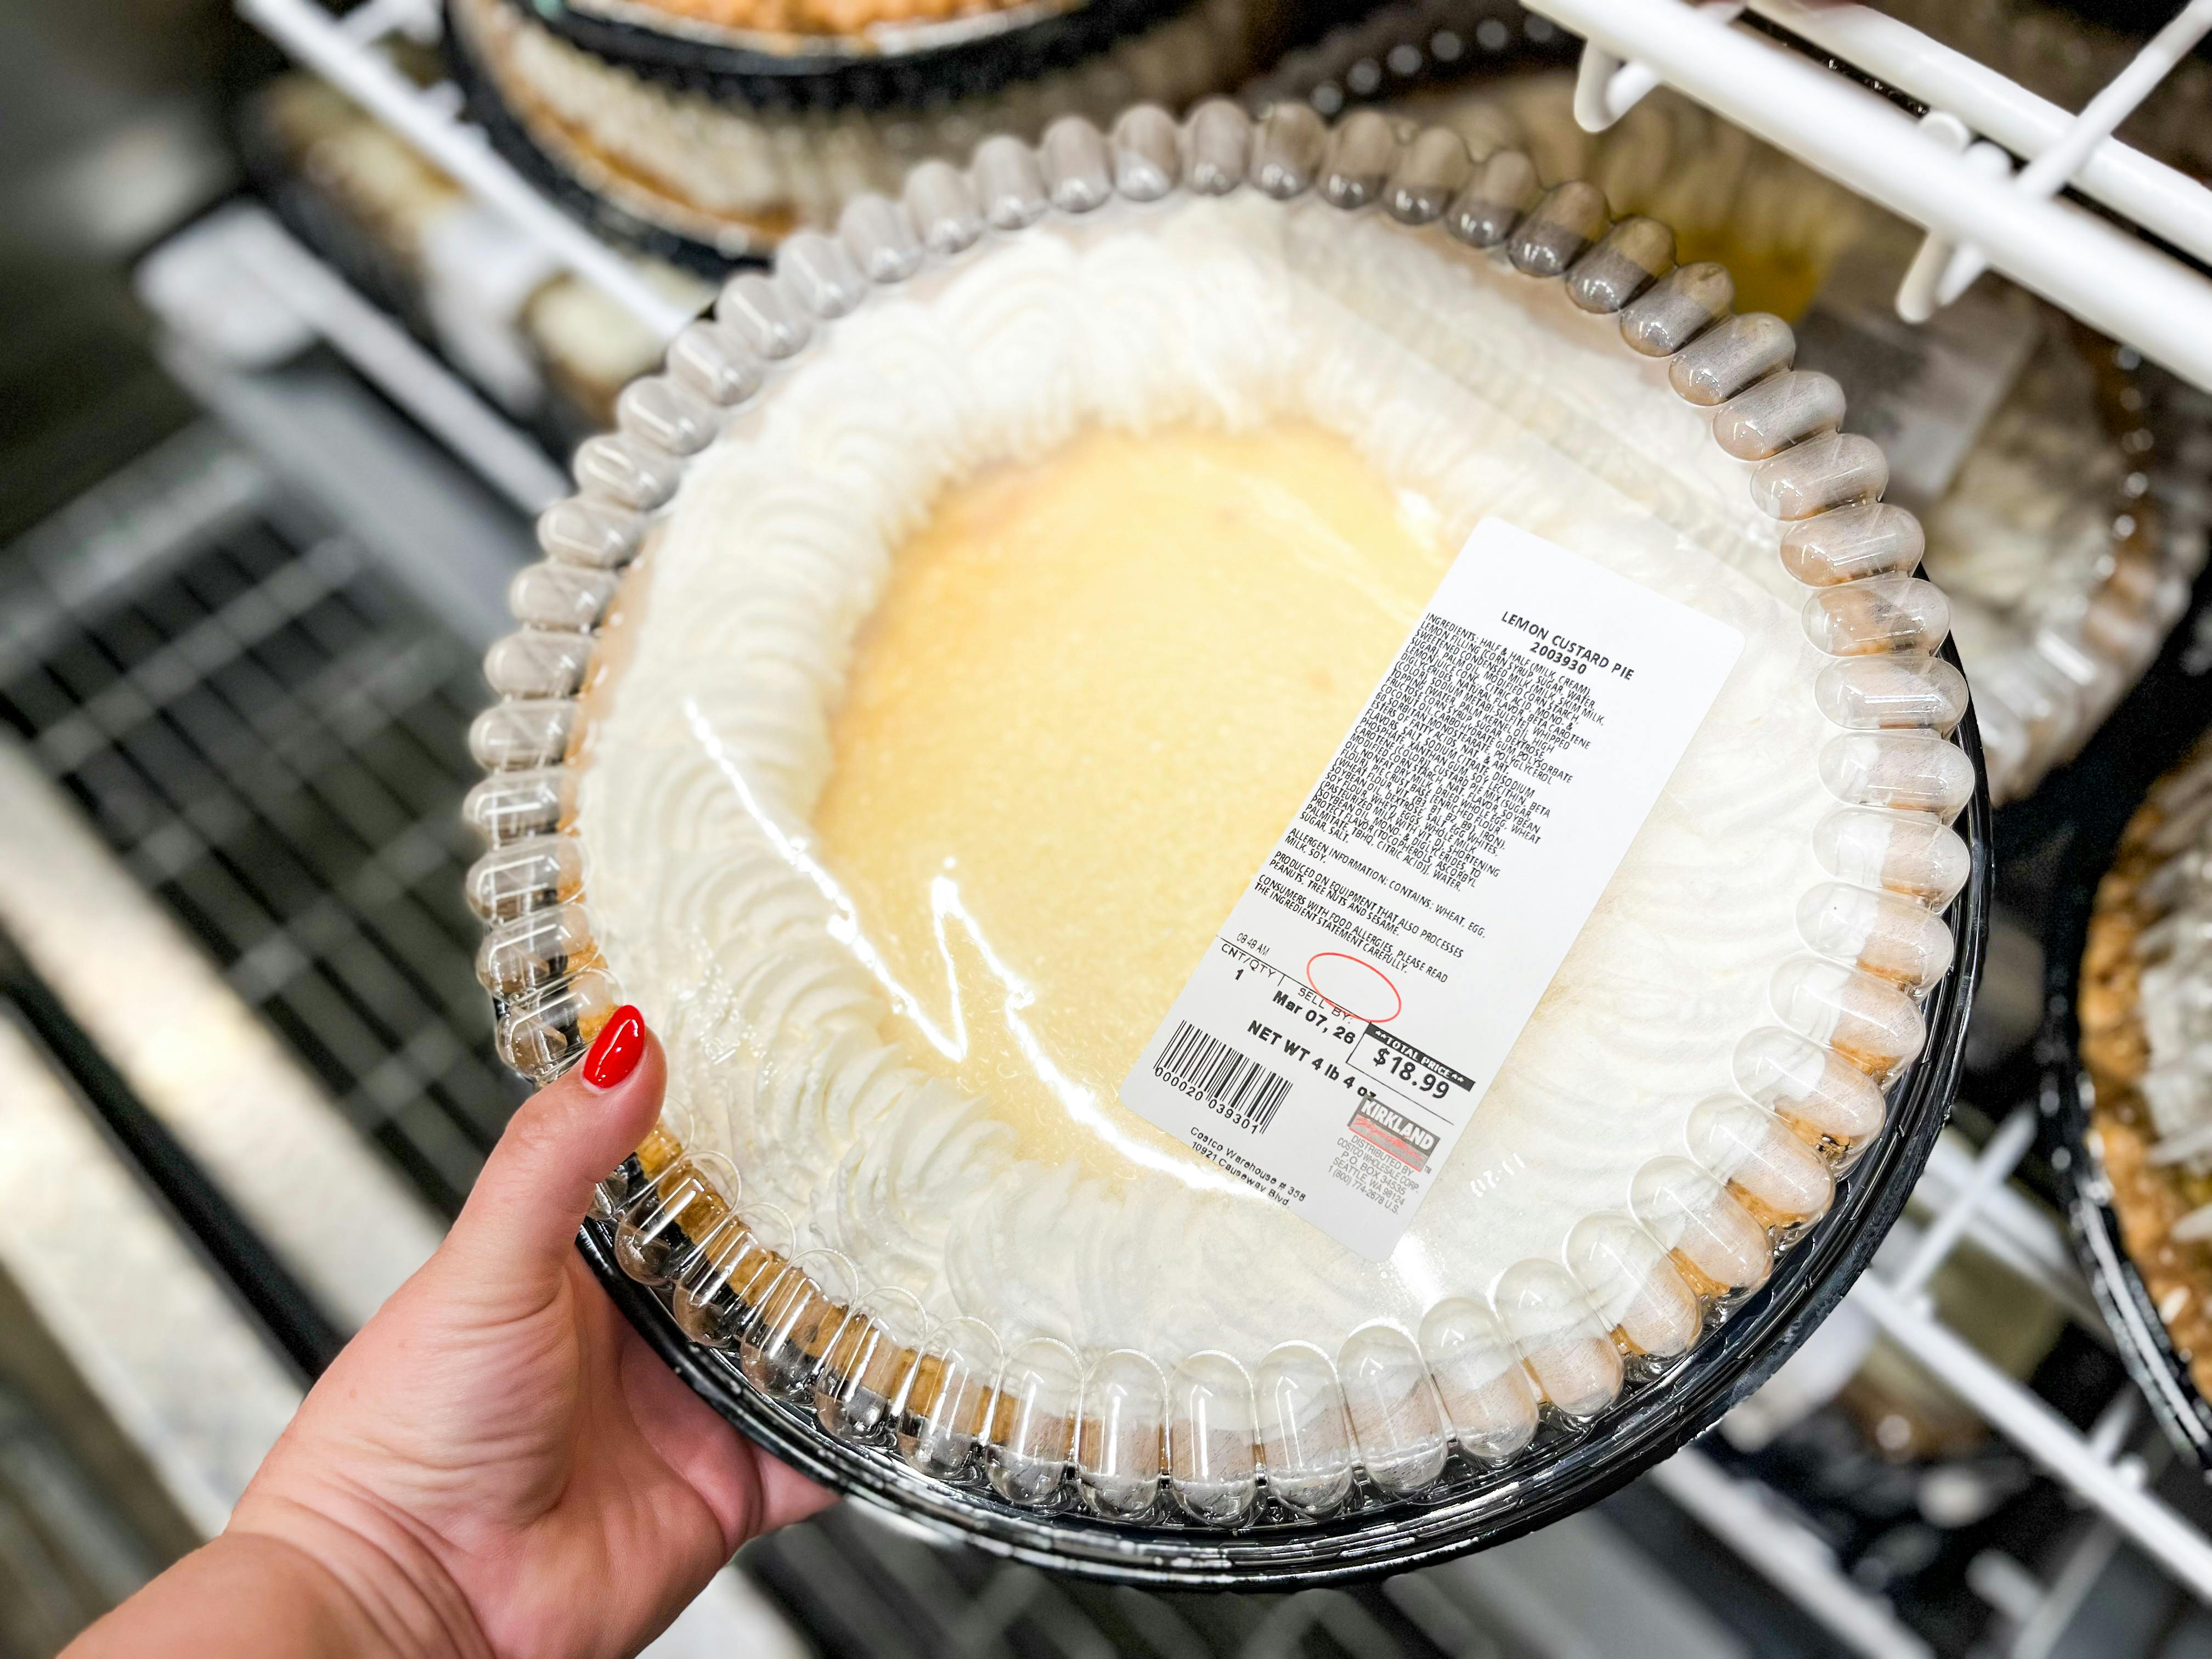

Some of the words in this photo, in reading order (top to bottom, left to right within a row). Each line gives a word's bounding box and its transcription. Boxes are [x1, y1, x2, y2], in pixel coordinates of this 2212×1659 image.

[1420, 620, 1451, 640] LEMON
[1449, 634, 1481, 654] FILLING
[1425, 612, 1479, 643] INGREDIENTS:
[1479, 637, 1502, 652] HALF
[1508, 651, 1531, 667] HALF
[1501, 611, 1549, 640] LEMON
[1551, 635, 1609, 668] CUSTARD
[1611, 662, 1635, 681] PIE
[1530, 641, 1587, 675] 2003930
[1380, 684, 1420, 707] COCONUT
[1385, 675, 1424, 699] FRUCTOSE
[1423, 692, 1447, 711] CORN
[1405, 645, 1436, 664] LEMON
[1433, 658, 1457, 674] JUICE
[1485, 682, 1511, 701] CITRIC
[1534, 707, 1564, 725] MONO-
[1415, 628, 1460, 655] SWEETENED
[1460, 650, 1508, 678] CONDENSED
[1508, 673, 1531, 689] MILK
[1558, 697, 1582, 713] SKIM
[1442, 652, 1466, 668] PALM
[1483, 671, 1523, 696] MODIFIED
[1523, 691, 1548, 708] CORN
[1370, 699, 1397, 718] ESTERS
[1409, 718, 1435, 735] FATTY
[1460, 744, 1480, 760] NAT.
[1491, 760, 1509, 775] ART.
[1391, 667, 1426, 690] TOPPING
[1458, 701, 1483, 719] PALM
[1482, 713, 1513, 734] KERNEL
[1531, 737, 1555, 754] HIGH
[1430, 676, 1464, 698] SODIUM
[1532, 726, 1570, 750] WHIPPED
[1455, 678, 1492, 702] NATURAL
[1527, 713, 1548, 730] BETA
[1548, 724, 1591, 749] CAROTENE
[1334, 757, 1367, 777] (WHEAT
[1395, 786, 1409, 800] VIT.
[1350, 732, 1389, 757] MODIFIED
[1389, 752, 1413, 770] CORN
[1446, 781, 1465, 797] NAT.
[1500, 809, 1541, 834] SOYBEAN
[1355, 725, 1395, 750] CAROTENE
[1433, 764, 1469, 787] CUSTARD
[1469, 782, 1483, 794] PIE
[1482, 789, 1502, 804] MIX
[1407, 741, 1448, 766] XANTHAN
[1470, 772, 1489, 786] SOY
[1528, 802, 1550, 818] BETA
[1423, 737, 1458, 760] SODIUM
[1492, 771, 1535, 799] DISODIUM
[1493, 750, 1553, 785] POLYGLYCEROL
[1320, 780, 1373, 811] (PASTEURIZED
[1373, 806, 1396, 822] MILK
[1395, 817, 1418, 834] WITH
[1418, 829, 1432, 843] VIT.
[1447, 844, 1500, 877] SHORTENING
[1325, 772, 1343, 785] SOY
[1424, 822, 1454, 843] WHOLE
[1453, 838, 1477, 854] MILK
[1330, 763, 1368, 788] SOYBEAN
[1449, 824, 1466, 838] EGG
[1370, 764, 1385, 776] PIE
[1385, 771, 1410, 788] CRUST
[1409, 783, 1431, 799] BASE
[1474, 816, 1500, 836] FLOUR
[1373, 816, 1402, 836] MONO-
[1393, 765, 1412, 778] DRY
[1435, 786, 1460, 803] DRIED
[1460, 798, 1490, 819] WHOLE
[1511, 824, 1541, 844] WHEAT
[1308, 848, 1327, 864] SOY.
[1310, 794, 1345, 817] PROTECT
[1343, 812, 1374, 834] FLAVOR
[1435, 861, 1476, 888] ASCORBYL
[1328, 826, 1350, 843] SALT.
[1376, 840, 1403, 859] CITRIC
[1289, 828, 1329, 854] ALLERGEN
[1328, 848, 1389, 885] INFORMATION:
[1389, 880, 1434, 910] CONTAINS:
[1254, 882, 1271, 896] THE
[1269, 891, 1318, 921] INGREDIENT
[1316, 917, 1364, 947] STATEMENT
[1363, 943, 1408, 973] CAREFULLY.
[1259, 874, 1307, 905] CONSUMERS
[1307, 900, 1330, 918] WITH
[1328, 912, 1352, 930] FOOD
[1396, 950, 1426, 971] PLEASE
[1425, 966, 1448, 983] READ
[1274, 851, 1316, 878] PRODUCED
[1314, 873, 1330, 887] ON
[1329, 881, 1378, 911] EQUIPMENT
[1376, 906, 1400, 923] THAT
[1397, 918, 1419, 934] ALSO
[1419, 929, 1464, 958] PROCESSES
[1307, 879, 1327, 895] TREE
[1325, 890, 1348, 906] NUTS
[1347, 902, 1367, 916] AND
[1366, 912, 1399, 936] SESAME.
[1221, 941, 1277, 978] CNT/QTY
[1235, 969, 1244, 981] 1
[1256, 944, 1270, 956] AM
[1272, 990, 1303, 1014] Mar
[1332, 1025, 1356, 1045] 26
[1297, 988, 1329, 1009] SELL
[1331, 1006, 1355, 1024] BY:
[1247, 1019, 1283, 1045] NET
[1283, 1039, 1311, 1062] WT
[1311, 1057, 1324, 1071] 4
[1324, 1063, 1340, 1081] lb
[1342, 1076, 1356, 1089] 4
[1373, 1047, 1453, 1099] $18.99
[1361, 1098, 1437, 1152] KIRKLAND
[1190, 1127, 1223, 1152] Costco
[1226, 1147, 1277, 1184] Warehouse
[1278, 1182, 1286, 1190] #
[1288, 1186, 1306, 1201] 358
[1192, 1141, 1217, 1161] 10921
[1218, 1158, 1267, 1192] Causeway
[1336, 1136, 1365, 1159] COSTCO
[1361, 1152, 1401, 1181] WHOLESALE
[1399, 1175, 1422, 1194] CORP.
[1340, 1150, 1361, 1168] P.O.
[1359, 1161, 1381, 1181] BOX
[1379, 1174, 1408, 1197] 34535
[1350, 1134, 1403, 1171] DISTRIBUTED
[1401, 1165, 1415, 1178] BY
[1333, 1167, 1353, 1185] (800)
[1351, 1179, 1386, 1205] 774-2678
[1384, 1199, 1402, 1215] U.S.
[1368, 1177, 1384, 1193] WA
[1381, 1186, 1407, 1207] 98124
